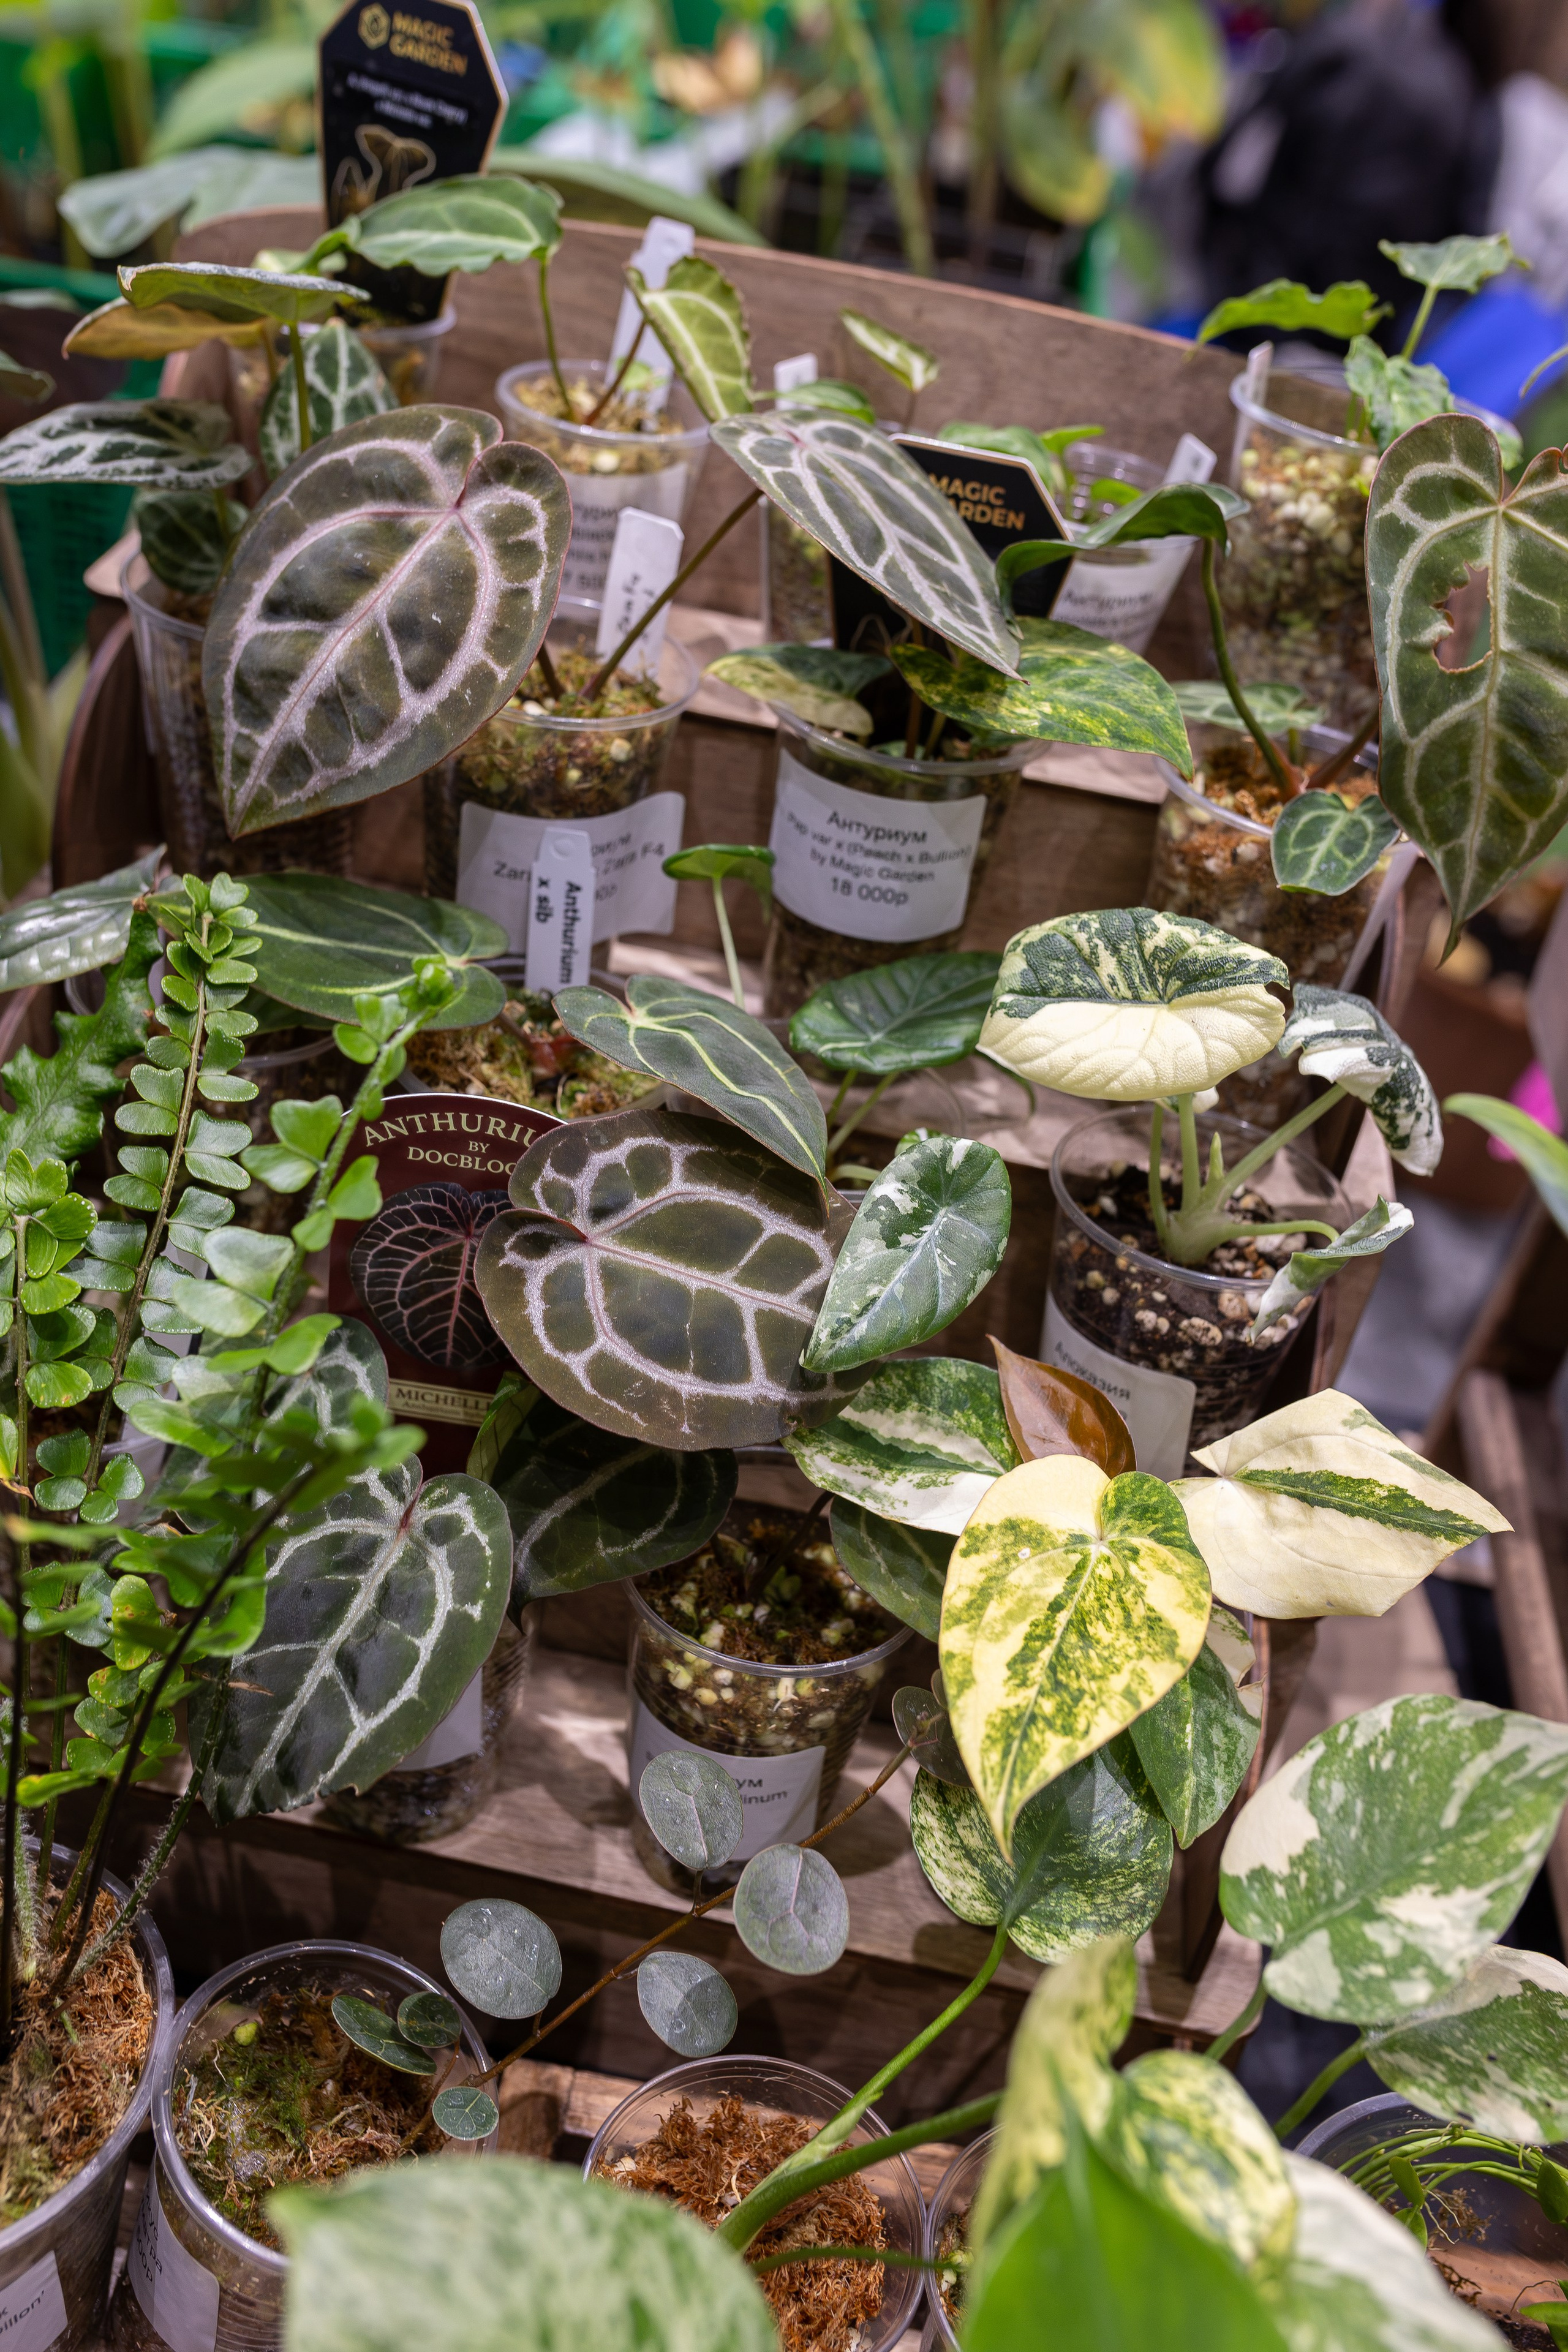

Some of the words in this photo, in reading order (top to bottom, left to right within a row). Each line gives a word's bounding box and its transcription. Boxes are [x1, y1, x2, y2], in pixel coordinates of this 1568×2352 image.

[949, 497, 1025, 531] RDEN
[827, 810, 927, 846] Антуриум
[831, 876, 853, 897] 18
[560, 880, 582, 984] Anthurium
[364, 1112, 537, 1148] ANTHURIU
[468, 1140, 490, 1153] BY
[407, 1146, 516, 1175] DOCBLOC
